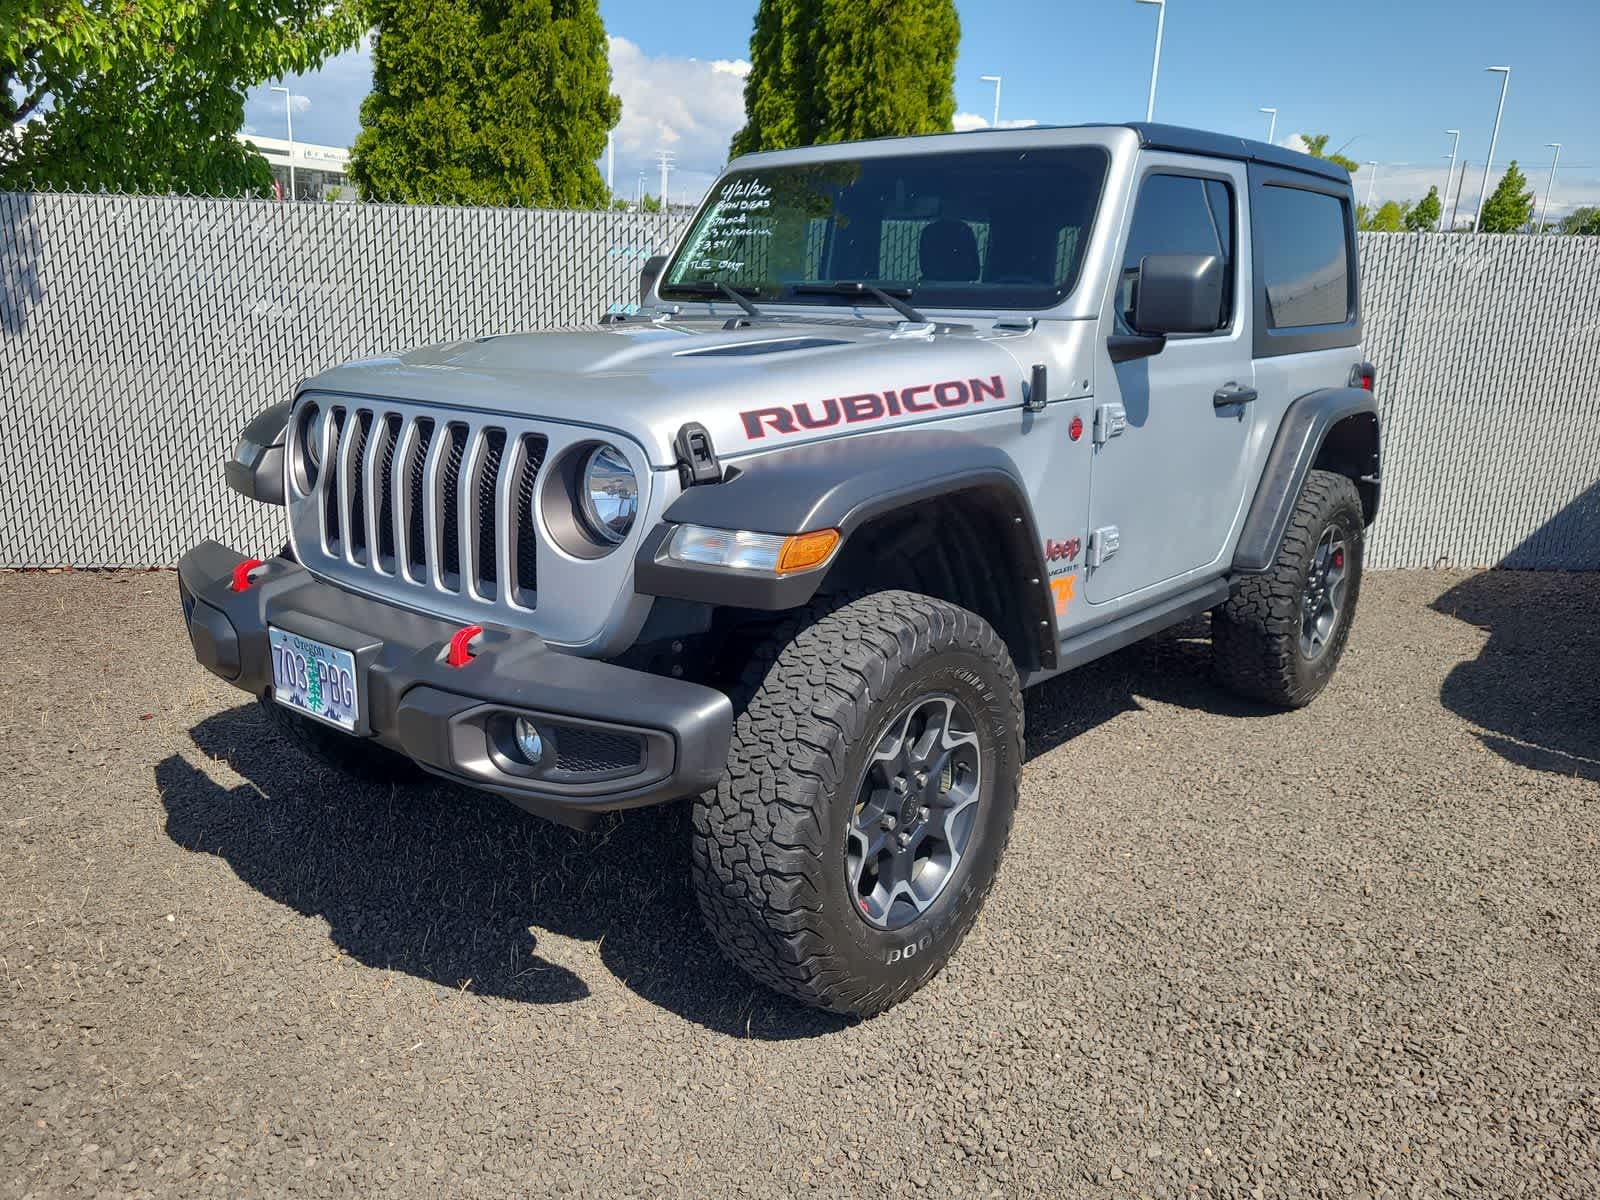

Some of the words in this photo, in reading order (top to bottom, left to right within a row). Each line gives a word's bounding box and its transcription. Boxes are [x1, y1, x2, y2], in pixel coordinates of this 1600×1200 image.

[738, 375, 1006, 440] RUBICON
[1044, 536, 1081, 562] Jeep
[294, 637, 326, 658] Oregon
[273, 643, 309, 693] 703
[317, 658, 354, 708] PBG
